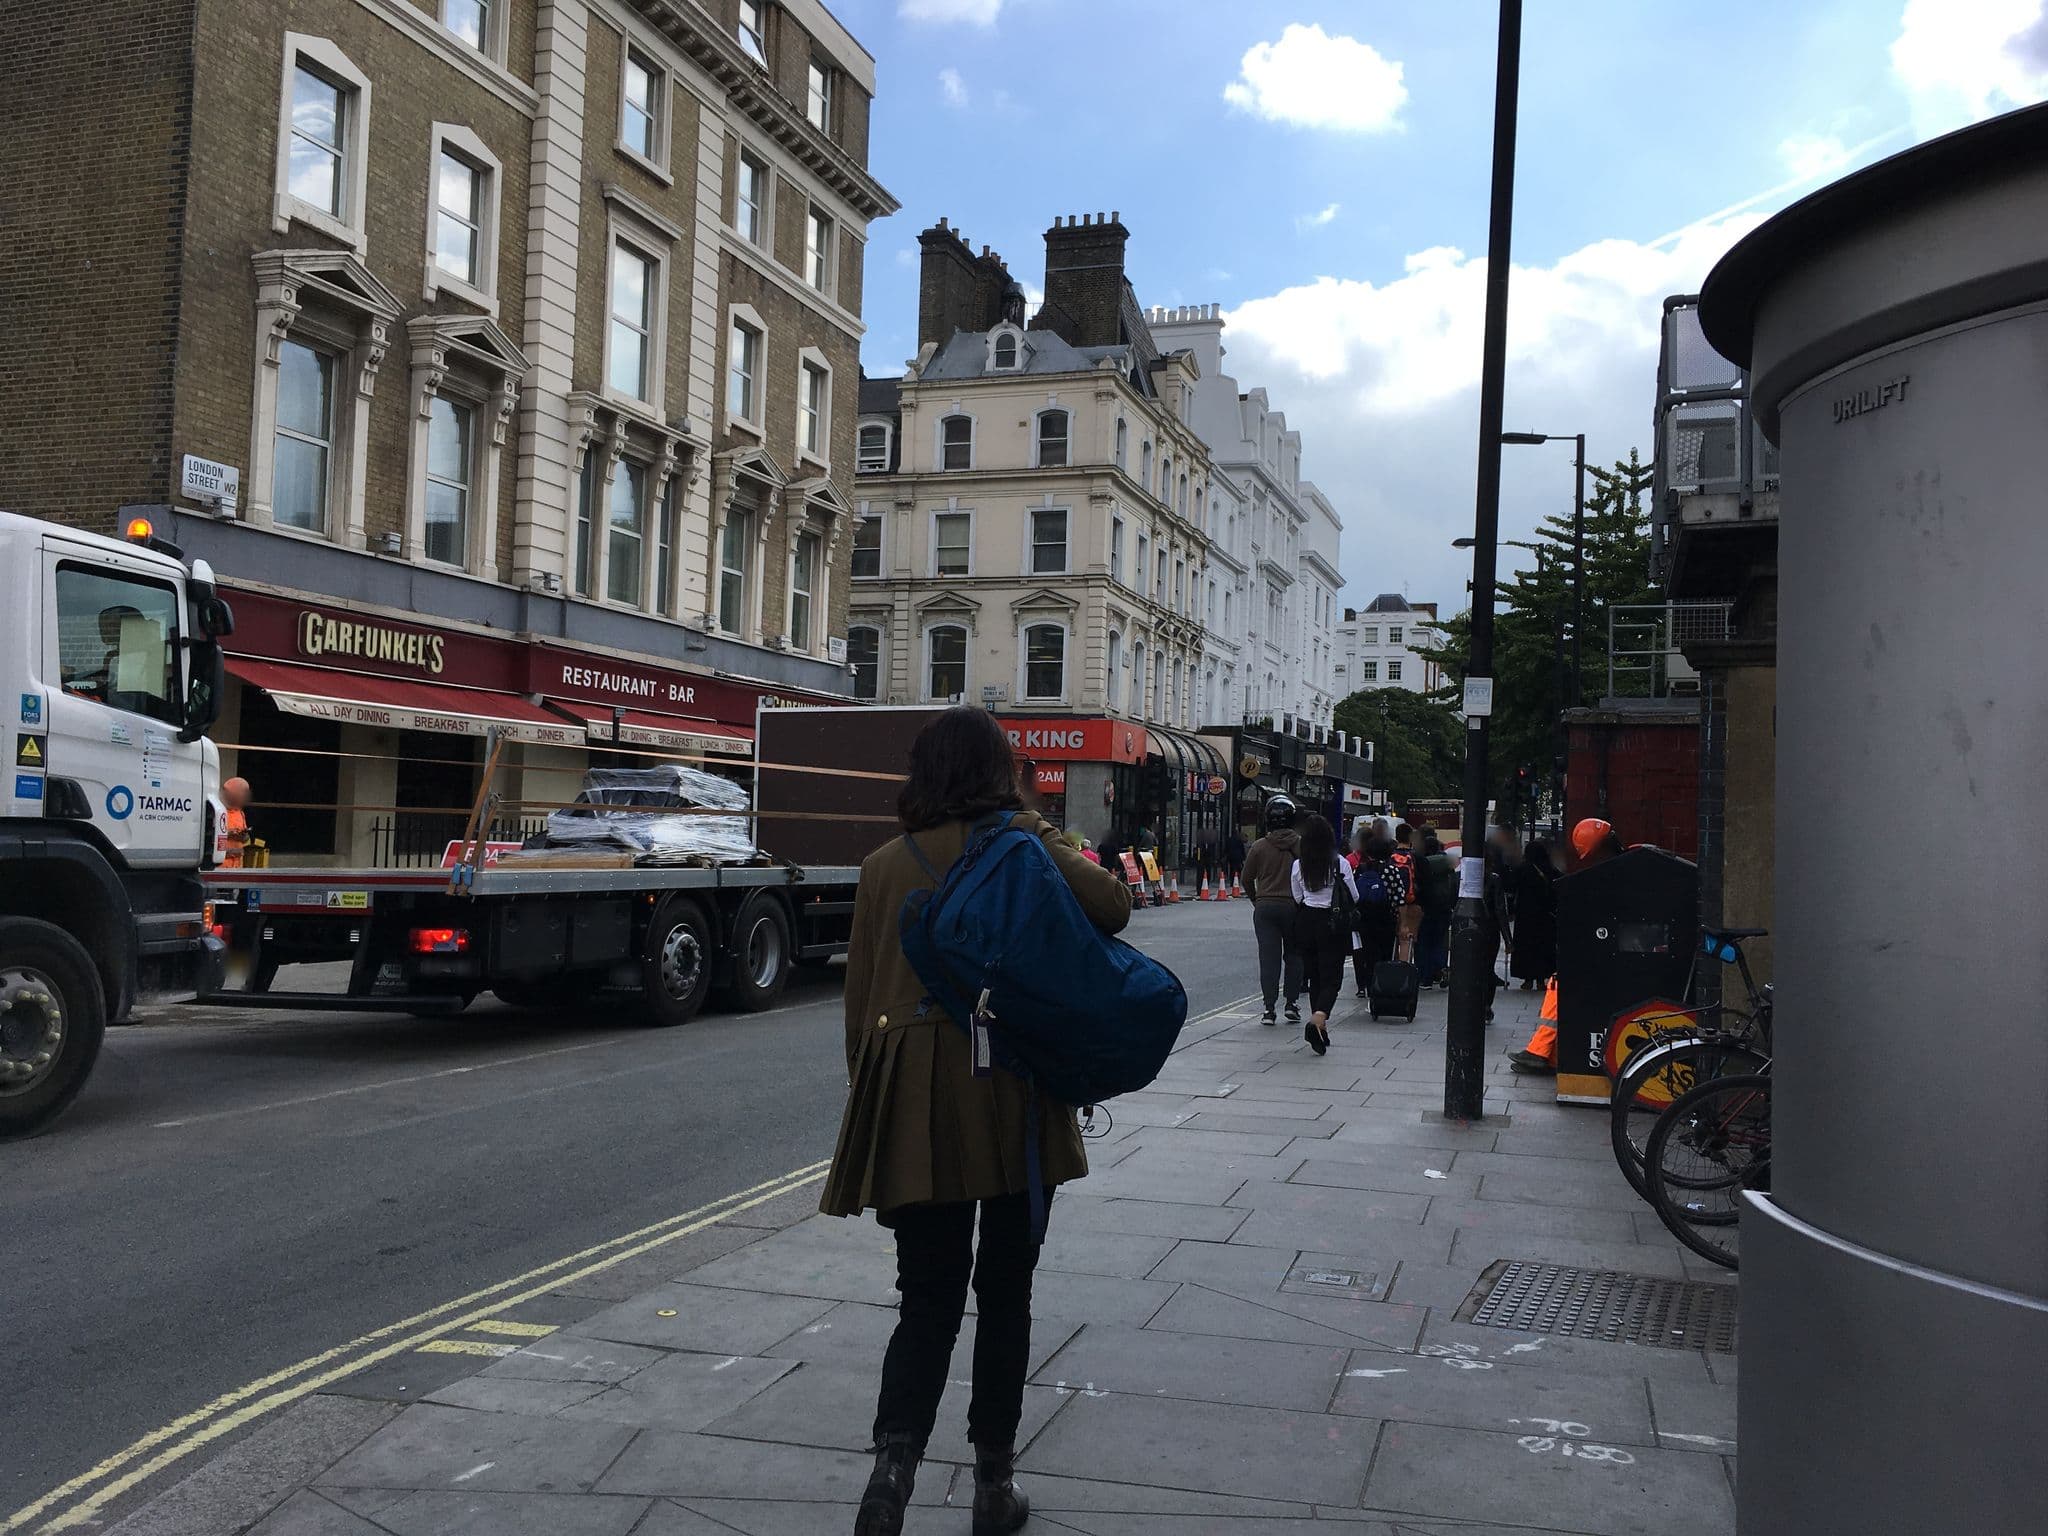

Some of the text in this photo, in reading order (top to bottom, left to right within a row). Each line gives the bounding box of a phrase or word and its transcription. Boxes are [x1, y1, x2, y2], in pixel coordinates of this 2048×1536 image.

[1833, 375, 1910, 424] URILIFT
[188, 459, 224, 479] LONDON
[188, 472, 220, 490] STREET
[223, 482, 237, 495] W2
[306, 612, 445, 674] GARFUNKEL'S
[562, 665, 695, 704] RESTAURANT BAR
[309, 703, 330, 716] ALL
[333, 705, 353, 719] DAY
[356, 709, 391, 724] DINING
[414, 715, 470, 733] BREAKFAST
[537, 728, 565, 741] DINNER
[600, 727, 613, 738] ALL
[630, 731, 652, 743] DINING
[658, 734, 694, 748] BREAKFAST
[700, 739, 720, 750] LUNCH
[724, 742, 745, 752] DINNER
[1025, 730, 1084, 749] KING
[1037, 771, 1065, 783] 2AM
[138, 795, 192, 811] TARMAC
